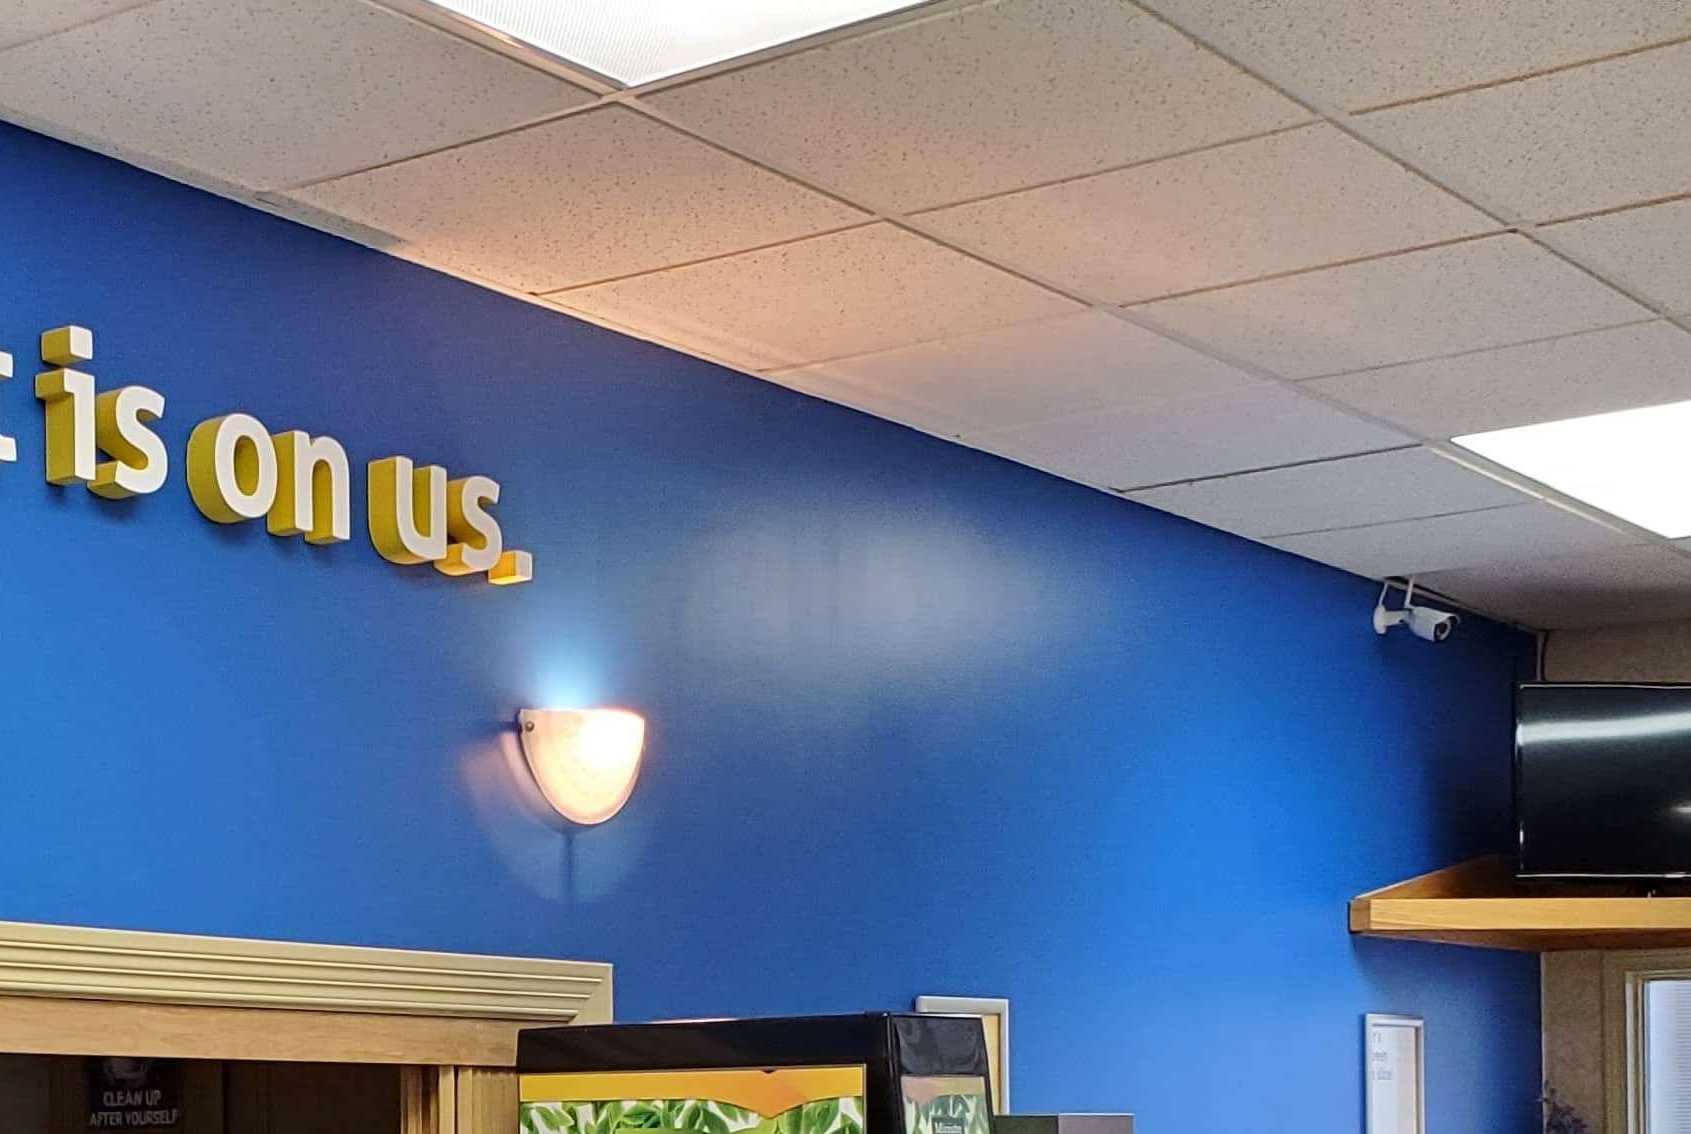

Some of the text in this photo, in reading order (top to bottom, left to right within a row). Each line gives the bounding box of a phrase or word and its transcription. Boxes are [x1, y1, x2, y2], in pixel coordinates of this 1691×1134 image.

[35, 325, 169, 500] is
[187, 412, 351, 544] on
[368, 455, 533, 585] us.
[103, 1090, 162, 1106] CLEAN UP
[90, 1109, 180, 1126] AFTER YOURSELF
